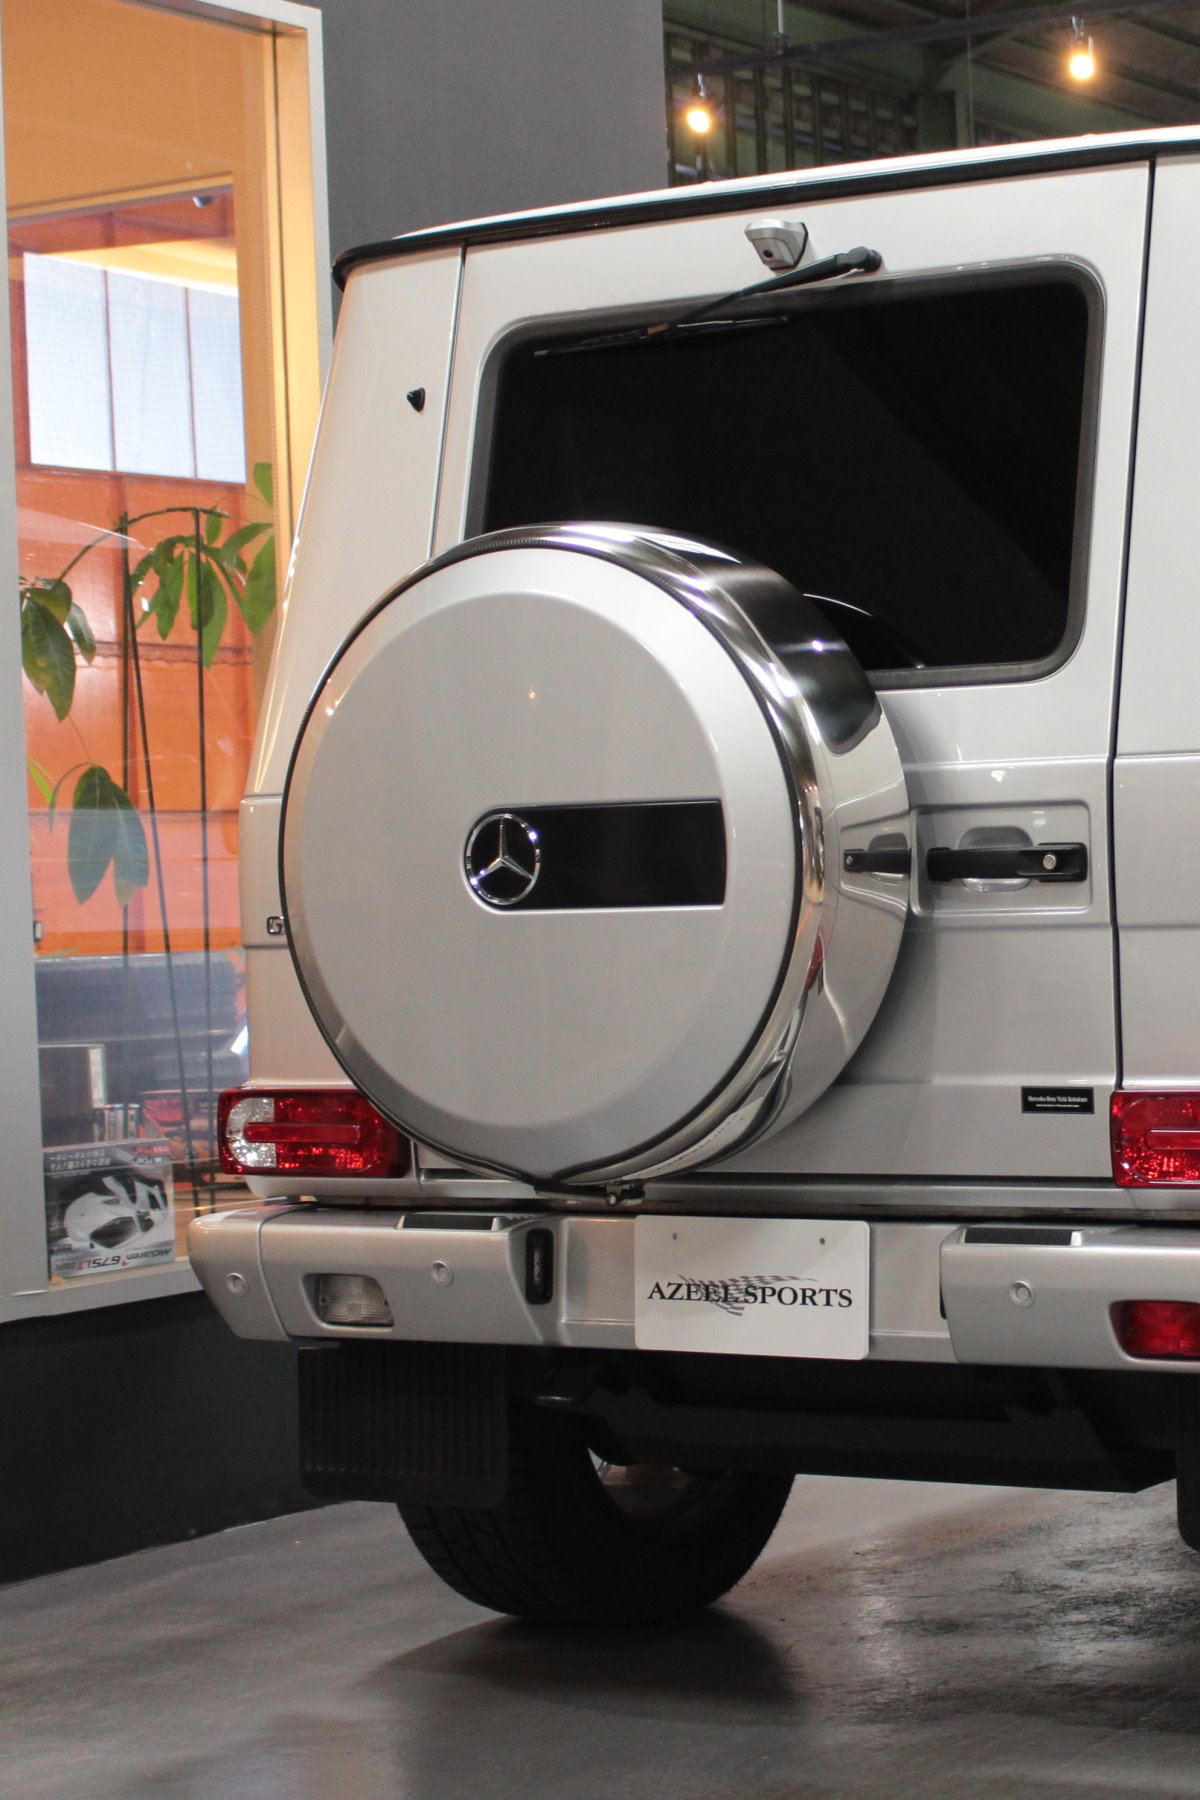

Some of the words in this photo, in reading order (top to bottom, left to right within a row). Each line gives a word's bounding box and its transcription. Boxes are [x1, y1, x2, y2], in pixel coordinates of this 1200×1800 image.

[77, 1254, 121, 1270] 675LT
[647, 1281, 742, 1303] AZEEL
[743, 1284, 853, 1308] SPORTS
